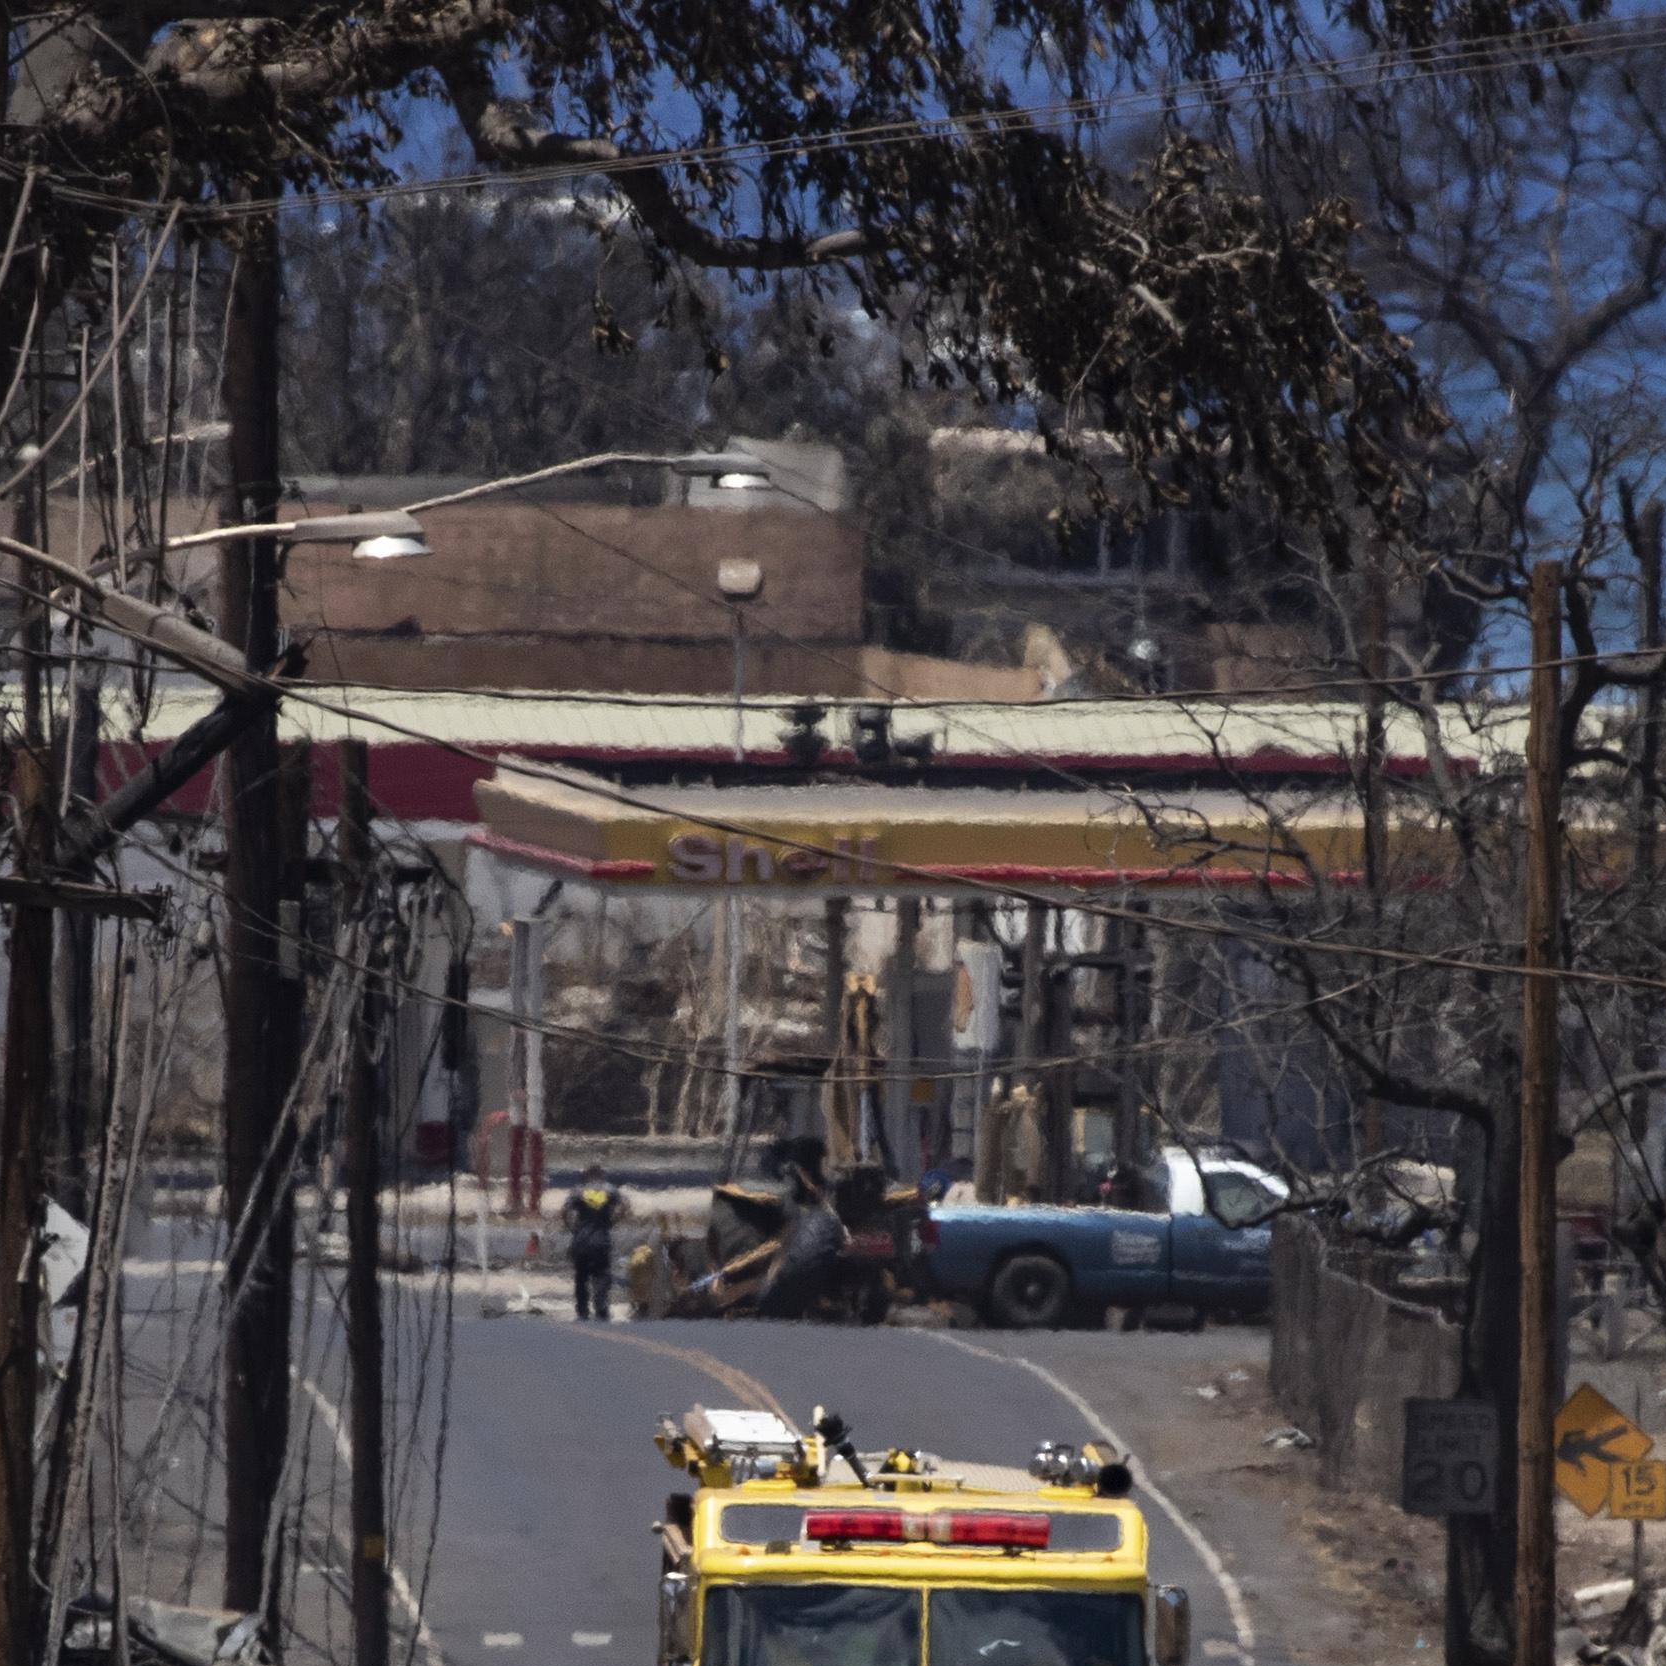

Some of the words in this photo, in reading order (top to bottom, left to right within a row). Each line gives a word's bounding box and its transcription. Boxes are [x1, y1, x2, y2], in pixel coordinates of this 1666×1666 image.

[667, 831, 879, 883] Shell
[1412, 1459, 1488, 1502] 20
[1621, 1465, 1658, 1497] 15
